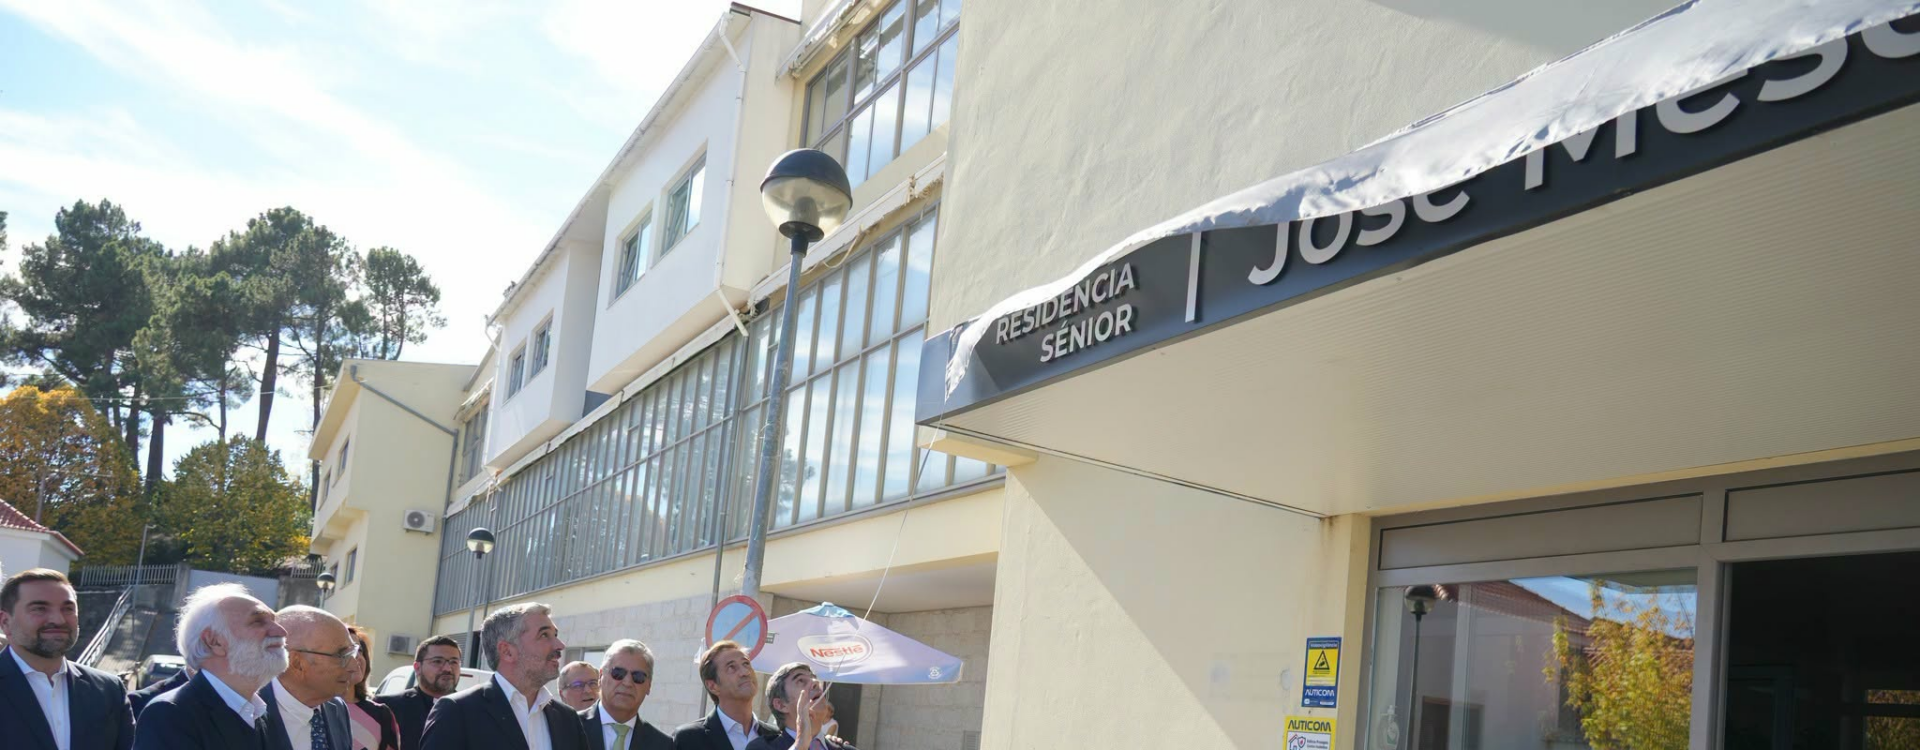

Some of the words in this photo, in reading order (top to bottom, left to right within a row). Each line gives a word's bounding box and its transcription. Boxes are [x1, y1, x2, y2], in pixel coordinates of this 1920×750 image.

[1525, 20, 1920, 191] es
[1040, 303, 1132, 362] SÉNIOR
[810, 645, 864, 658] Nestlé
[1304, 689, 1335, 697] AUTICOM
[1288, 720, 1332, 732] AUTICOM
